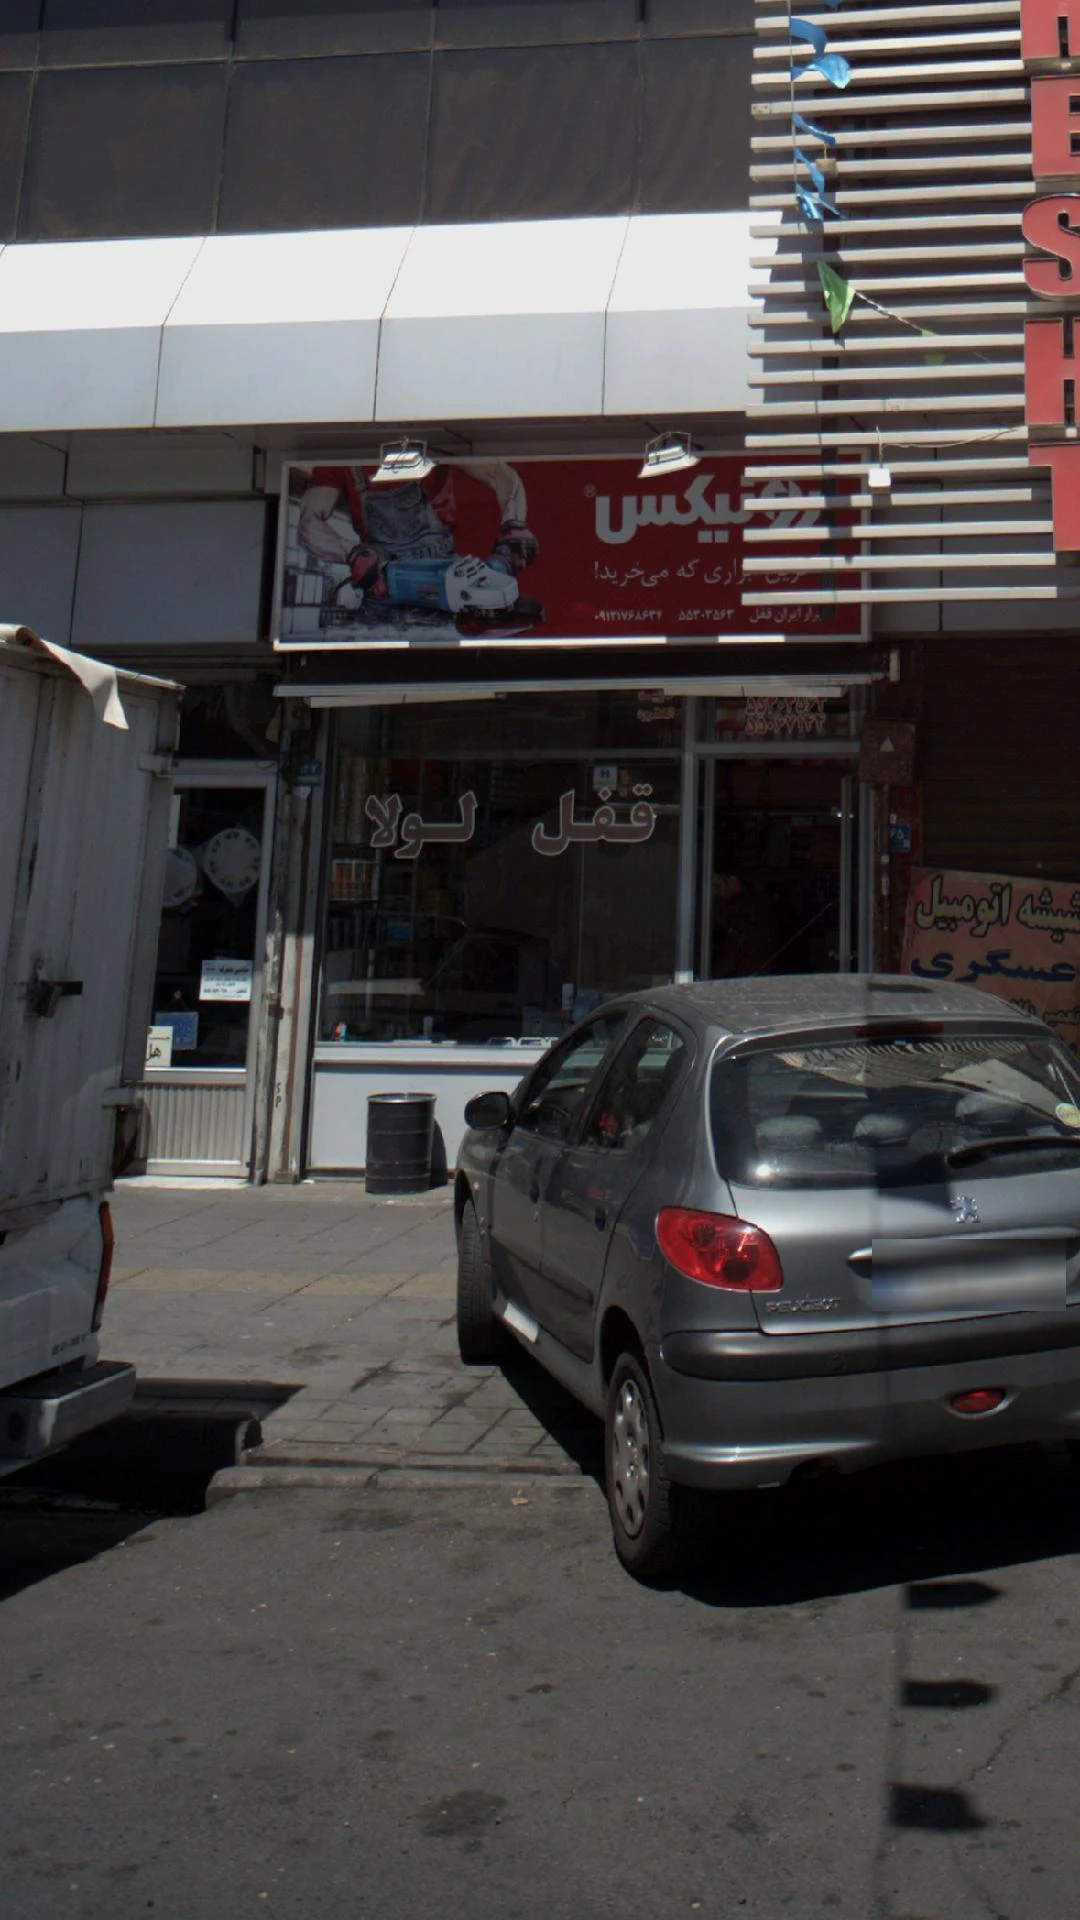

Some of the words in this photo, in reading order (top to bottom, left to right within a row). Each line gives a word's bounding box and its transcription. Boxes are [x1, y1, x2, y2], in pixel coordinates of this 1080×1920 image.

[676, 559, 700, 578] که
[364, 789, 479, 860] لولا
[531, 782, 657, 857] قفل
[914, 874, 1013, 938] اتومبیل
[765, 1297, 841, 1313] PEUGEOT
